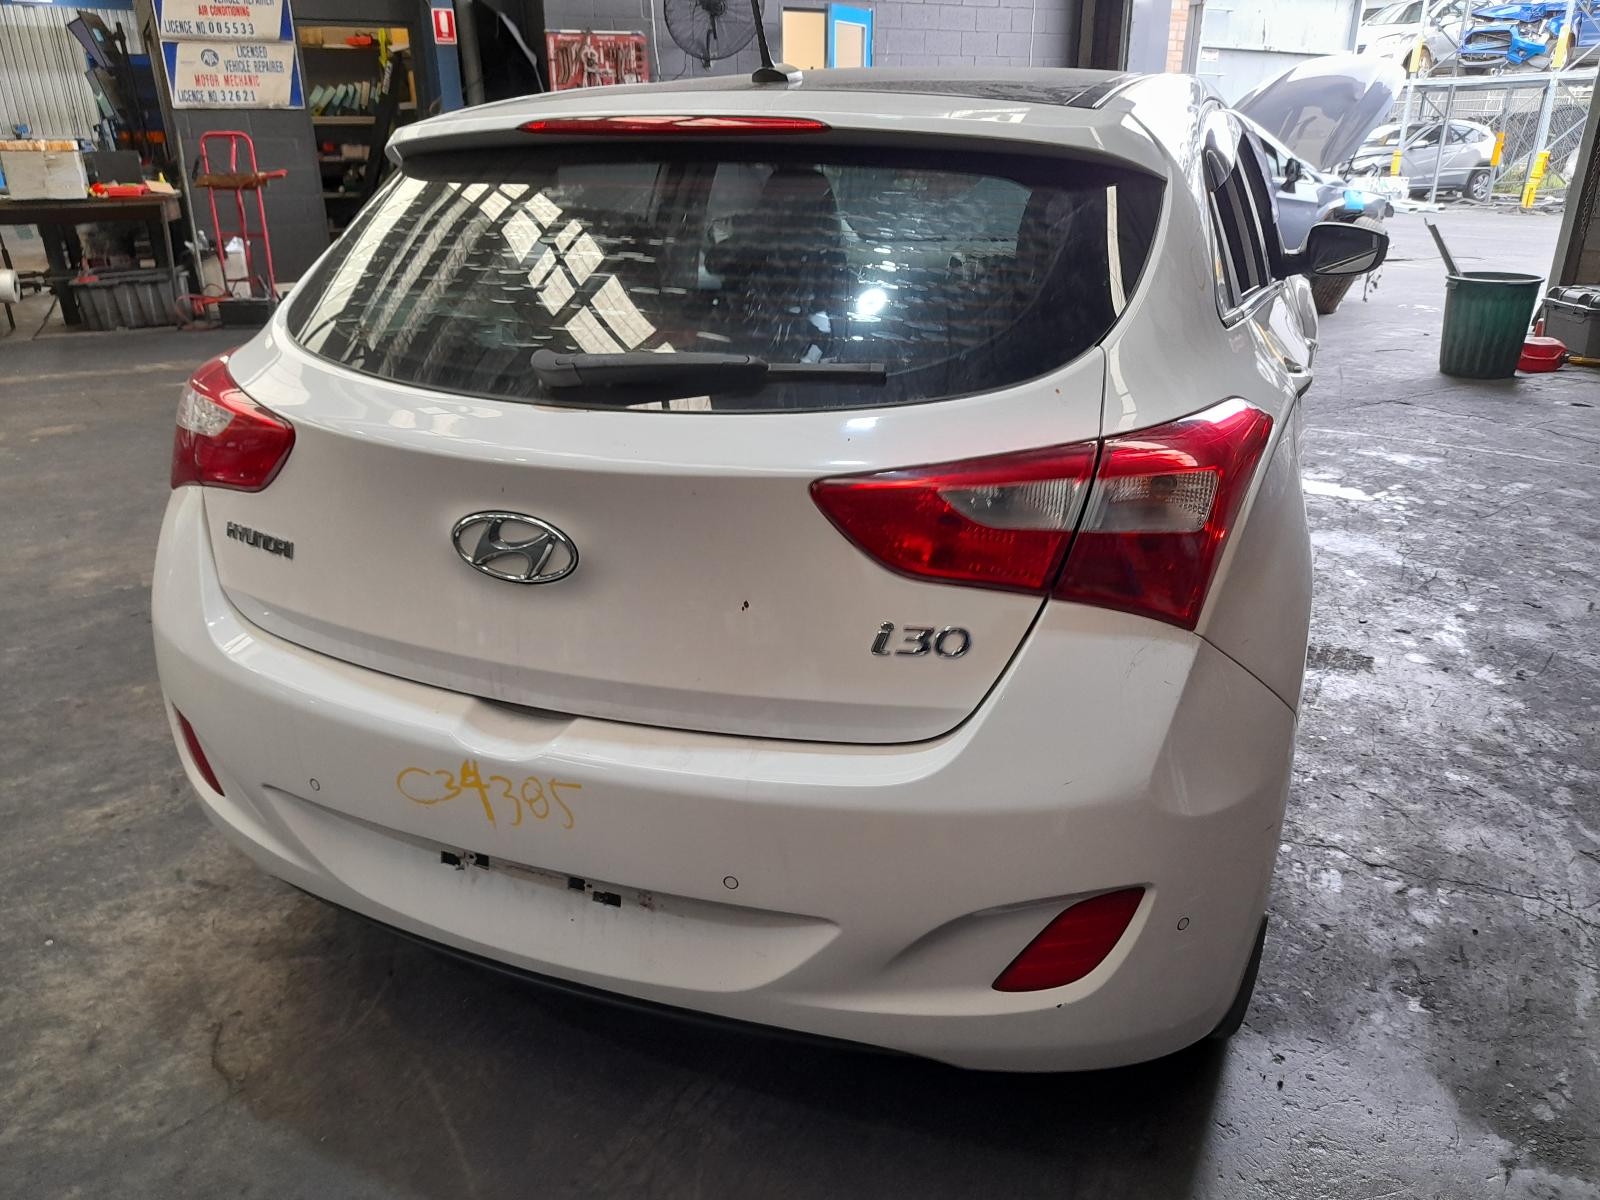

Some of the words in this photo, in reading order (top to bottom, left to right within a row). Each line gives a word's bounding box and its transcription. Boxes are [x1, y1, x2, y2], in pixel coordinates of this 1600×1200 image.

[198, 5, 208, 16] AIR
[210, 6, 250, 17] CONDITIONING
[164, 20, 192, 34] LICENCE
[208, 21, 255, 35] 005533
[236, 45, 268, 58] LICENSED
[224, 60, 251, 73] VEHICLE
[253, 61, 285, 73] REPAIRER
[194, 74, 220, 87] MOTOR
[223, 74, 261, 87] MECHANIC
[177, 89, 204, 103] LICENCE
[220, 90, 256, 102] 32621
[226, 520, 294, 560] HYUNDAI
[870, 620, 972, 660] i30
[396, 758, 583, 831] C34385
